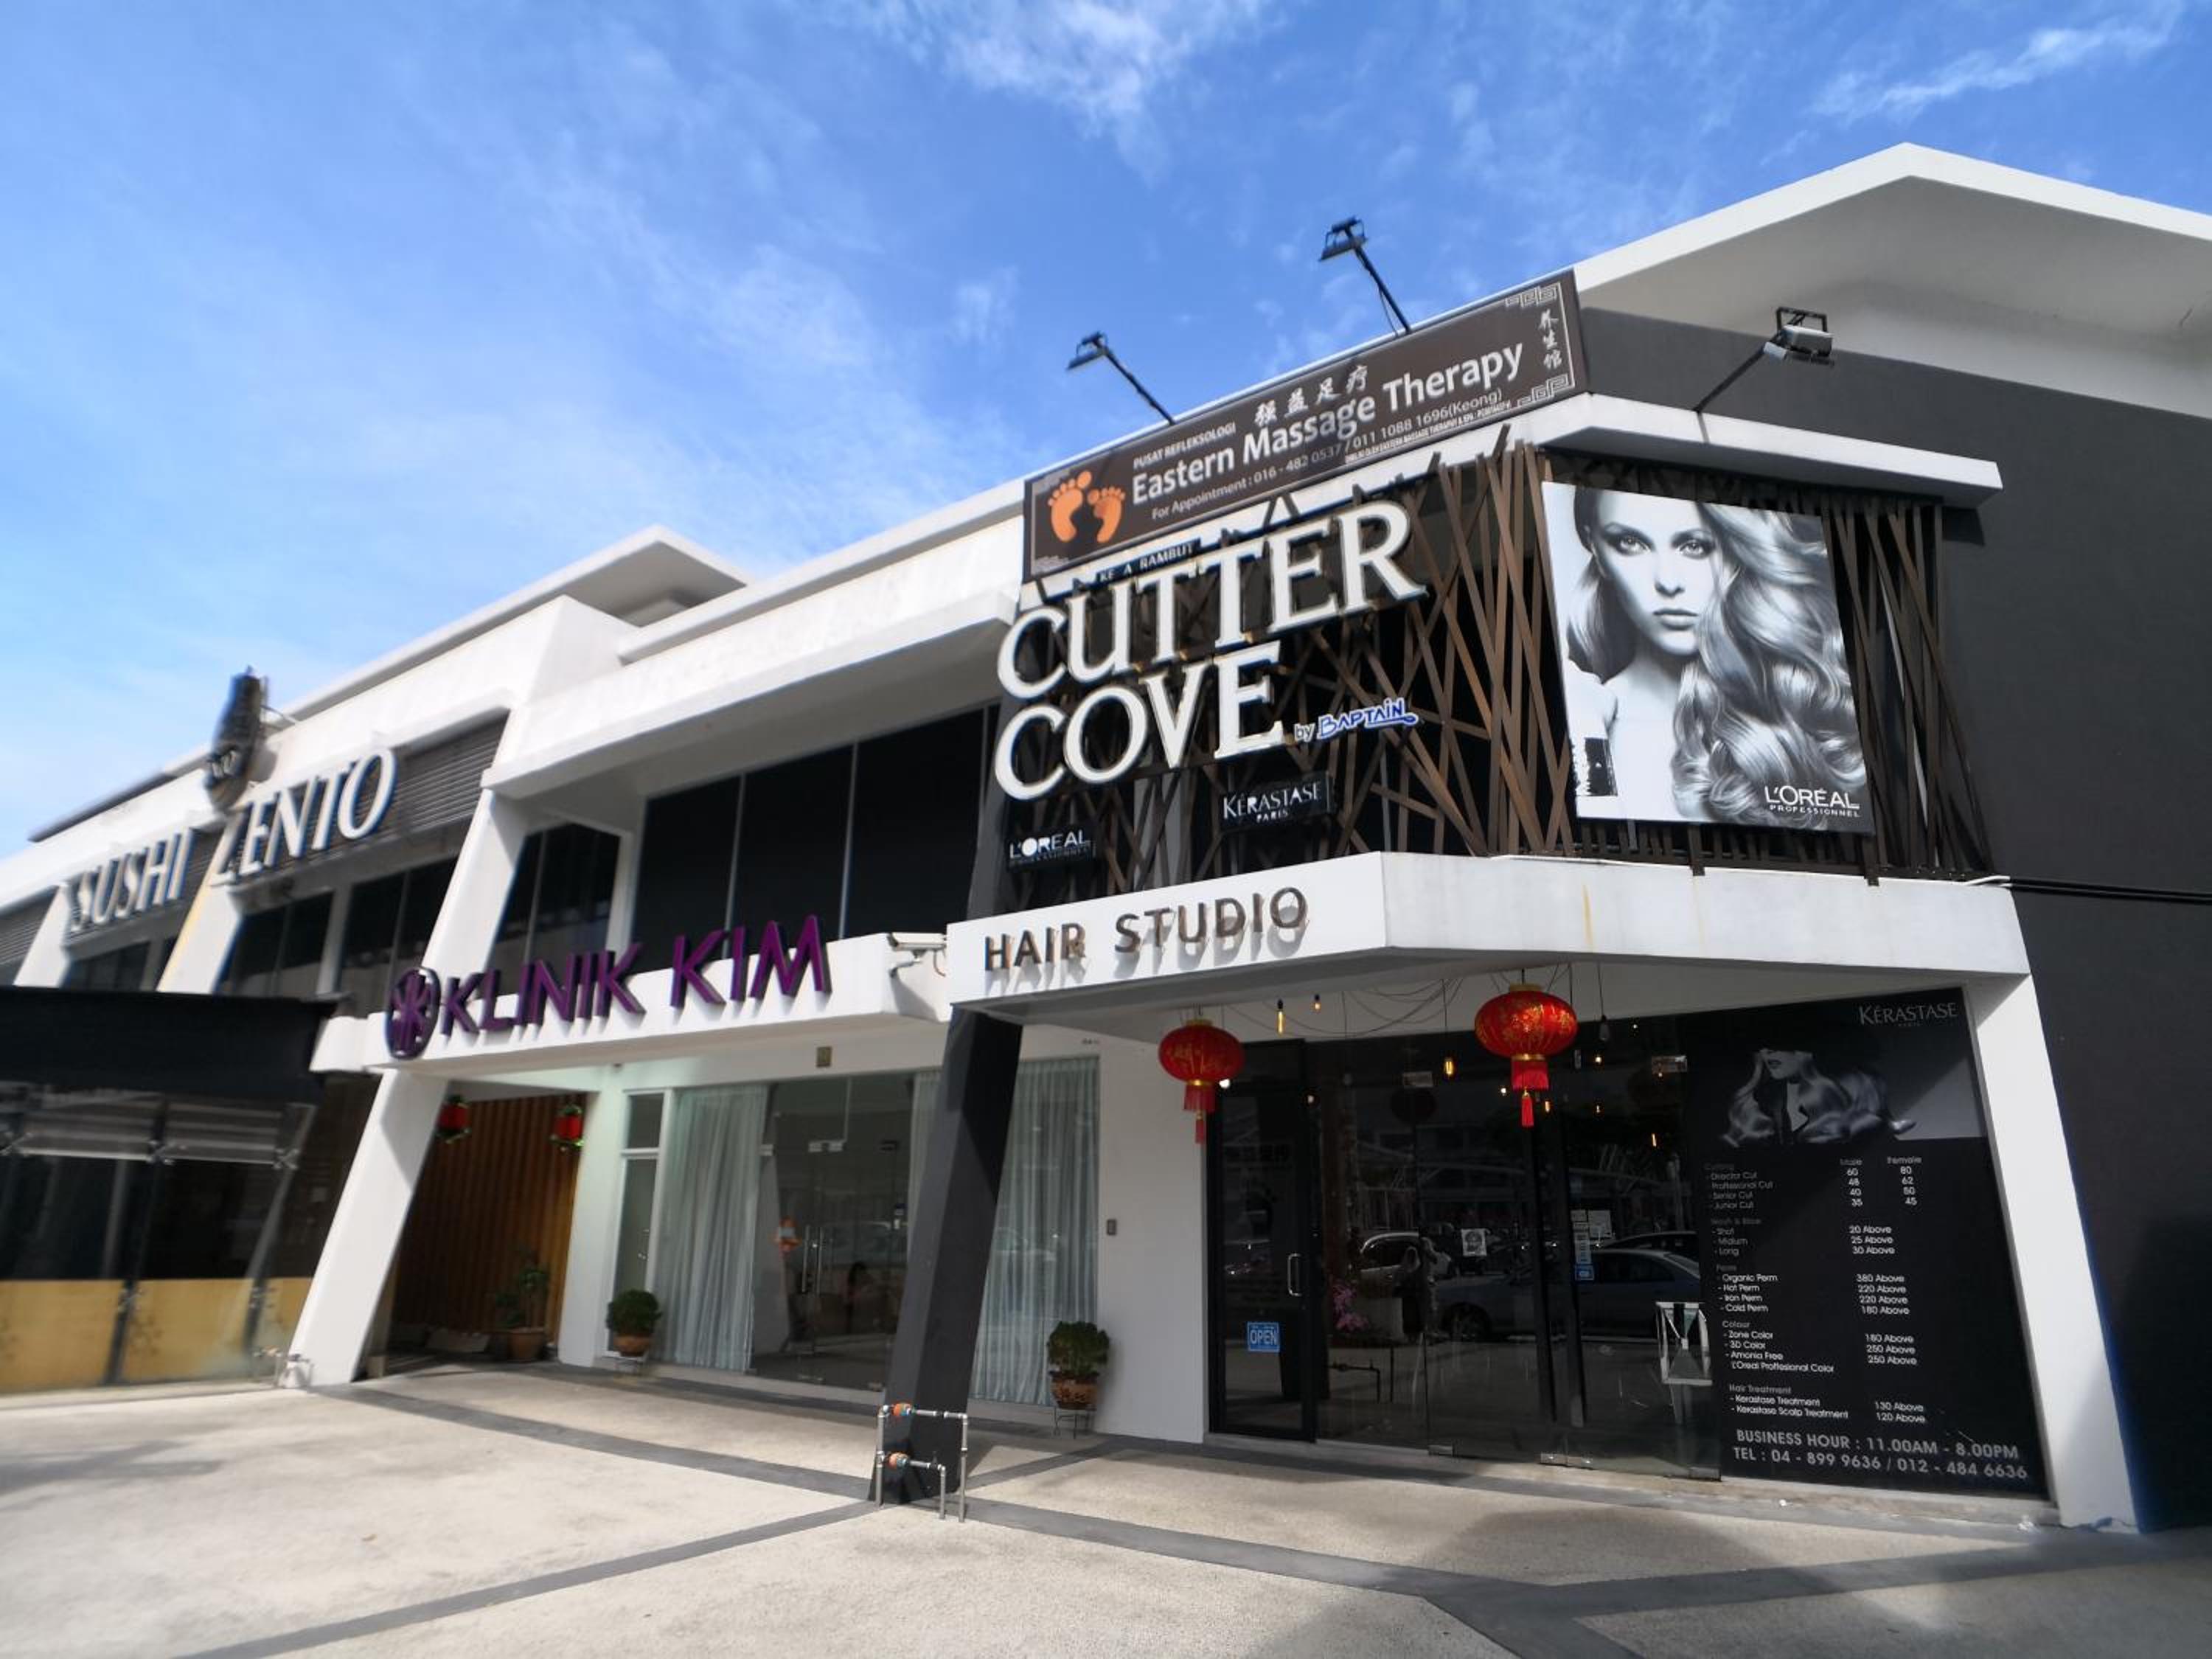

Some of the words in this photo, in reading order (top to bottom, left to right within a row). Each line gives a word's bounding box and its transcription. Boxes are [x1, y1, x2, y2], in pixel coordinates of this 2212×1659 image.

[1133, 447, 1234, 504] Eastern
[1243, 396, 1375, 465] Massage
[1382, 342, 1523, 411] Therapy
[1133, 450, 1163, 469] PUSAT
[1164, 421, 1237, 462] REFLEKSOLOGI
[1152, 506, 1169, 519] For
[1172, 479, 1247, 513] Appointment
[1254, 465, 1276, 483] 016
[1286, 454, 1308, 472] 482
[1311, 445, 1340, 462] 0537
[1354, 431, 1376, 448] 011
[1381, 419, 1411, 439] 1088
[1140, 543, 1194, 568] RAMBUT
[996, 499, 1427, 700] CUTTER
[995, 641, 1284, 800] COVE
[1294, 723, 1316, 742] by
[1764, 784, 1860, 810] L'ORÉAL
[1770, 804, 1860, 818] PROFESSIONNEL
[210, 748, 397, 885] ZENTO
[1256, 810, 1289, 824] PARIS
[70, 827, 194, 932] SUSHI
[985, 922, 1086, 971] HAIR
[1114, 887, 1309, 953] STUDIO
[442, 942, 647, 1036] KLINIK
[671, 915, 832, 1008] KIM
[1846, 1167, 1859, 1176] 60
[1902, 1176, 1913, 1185] 62
[1850, 1188, 1862, 1197] 40
[1905, 1197, 1917, 1206] 45
[1863, 1225, 1892, 1234] Above
[1865, 1235, 1893, 1244] Above
[1719, 1248, 1739, 1256] Long
[1852, 1246, 1865, 1254] 30
[1865, 1246, 1896, 1254] Above
[1722, 1274, 1755, 1283] Organic
[1875, 1274, 1905, 1282] Above
[1858, 1284, 1875, 1293] 220
[1877, 1284, 1906, 1293] Above
[1860, 1295, 1877, 1304] 220
[1879, 1295, 1908, 1304] Above
[1725, 1304, 1746, 1312] Cold
[1747, 1304, 1769, 1312] Perm
[1880, 1306, 1910, 1315] Above
[1251, 1329, 1277, 1346] OPEN
[1728, 1330, 1750, 1338] Zone
[1751, 1330, 1773, 1339] Color
[1884, 1334, 1913, 1343] Above
[1743, 1340, 1766, 1349] Color
[1885, 1345, 1916, 1354] Above
[1765, 1352, 1784, 1360] Free
[1868, 1355, 1885, 1363] 250
[1888, 1356, 1917, 1365] Above
[1811, 1363, 1834, 1373] Color
[1747, 1385, 1792, 1394] Treatment
[1735, 1394, 1775, 1405] Kerastase
[1778, 1397, 1820, 1407] Treatment
[1736, 1405, 1776, 1415] Kerastase
[1778, 1407, 1803, 1417] Scalp
[1804, 1408, 1849, 1419] Treatment
[1893, 1402, 1924, 1413] Above
[1896, 1413, 1926, 1424] Above
[1736, 1429, 1802, 1446] BUSINESS
[1807, 1433, 1851, 1449] HOUR
[1867, 1437, 1938, 1454] 11.00AM
[1955, 1442, 2019, 1459] 8.00PM
[1734, 1447, 1756, 1461] TEL
[1771, 1449, 1791, 1463] 04
[1807, 1452, 1835, 1466] 899
[1841, 1454, 1881, 1470] 9636
[1897, 1458, 1929, 1473] 012
[1946, 1461, 1978, 1475] 484
[1983, 1463, 2028, 1479] 6636
